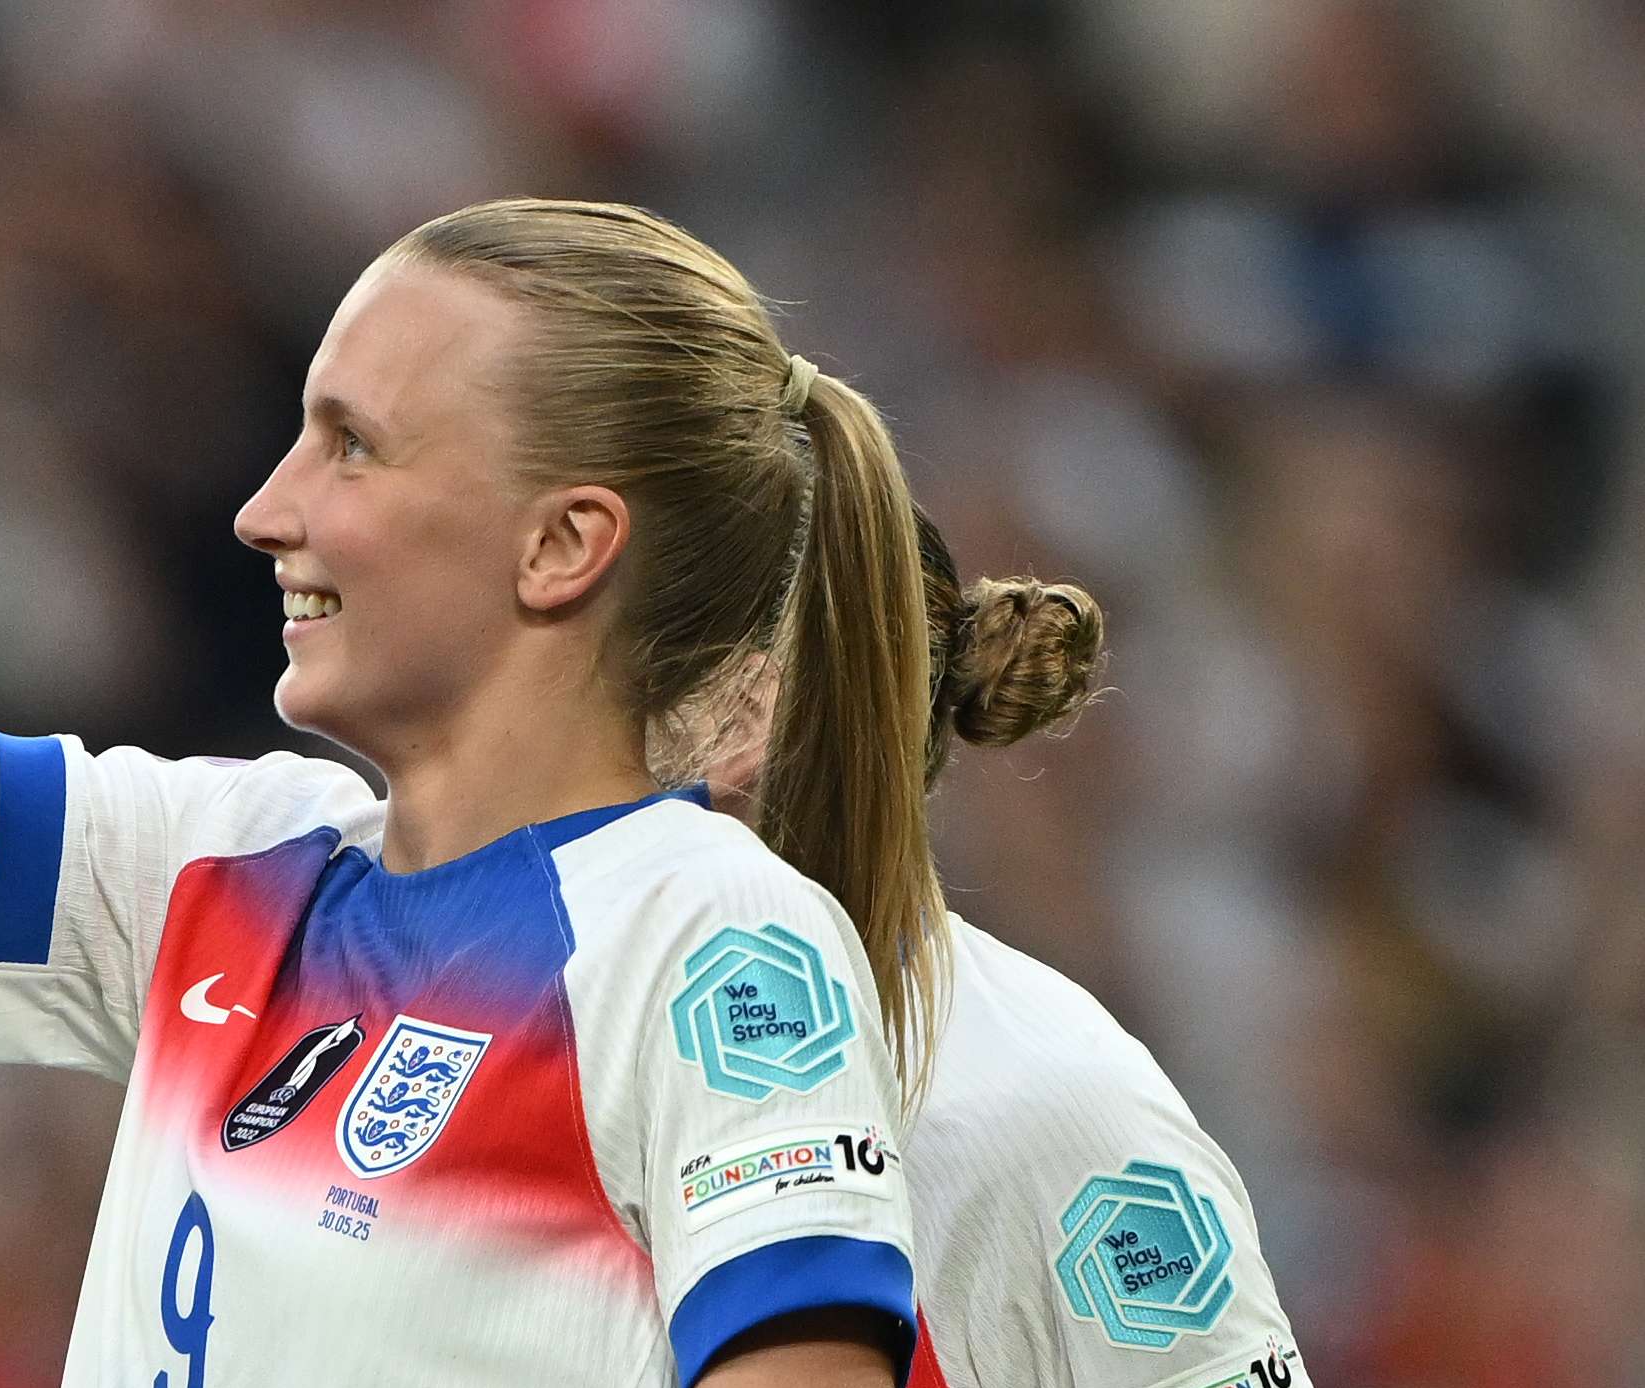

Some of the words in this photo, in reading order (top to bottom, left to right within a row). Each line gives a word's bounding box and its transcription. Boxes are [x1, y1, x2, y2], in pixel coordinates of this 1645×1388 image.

[724, 982, 758, 1000] We
[732, 1020, 806, 1042] Strong
[230, 1127, 259, 1140] 2022
[680, 1154, 712, 1178] UEFA
[683, 1146, 832, 1204] FOUNDATION
[834, 1134, 885, 1176] 10
[775, 1177, 789, 1194] for
[793, 1172, 835, 1187] children
[325, 1184, 379, 1218] PORTUGAL
[318, 1209, 371, 1241] 30.05.25
[1104, 1230, 1139, 1250] We
[1123, 1255, 1194, 1292] Strong
